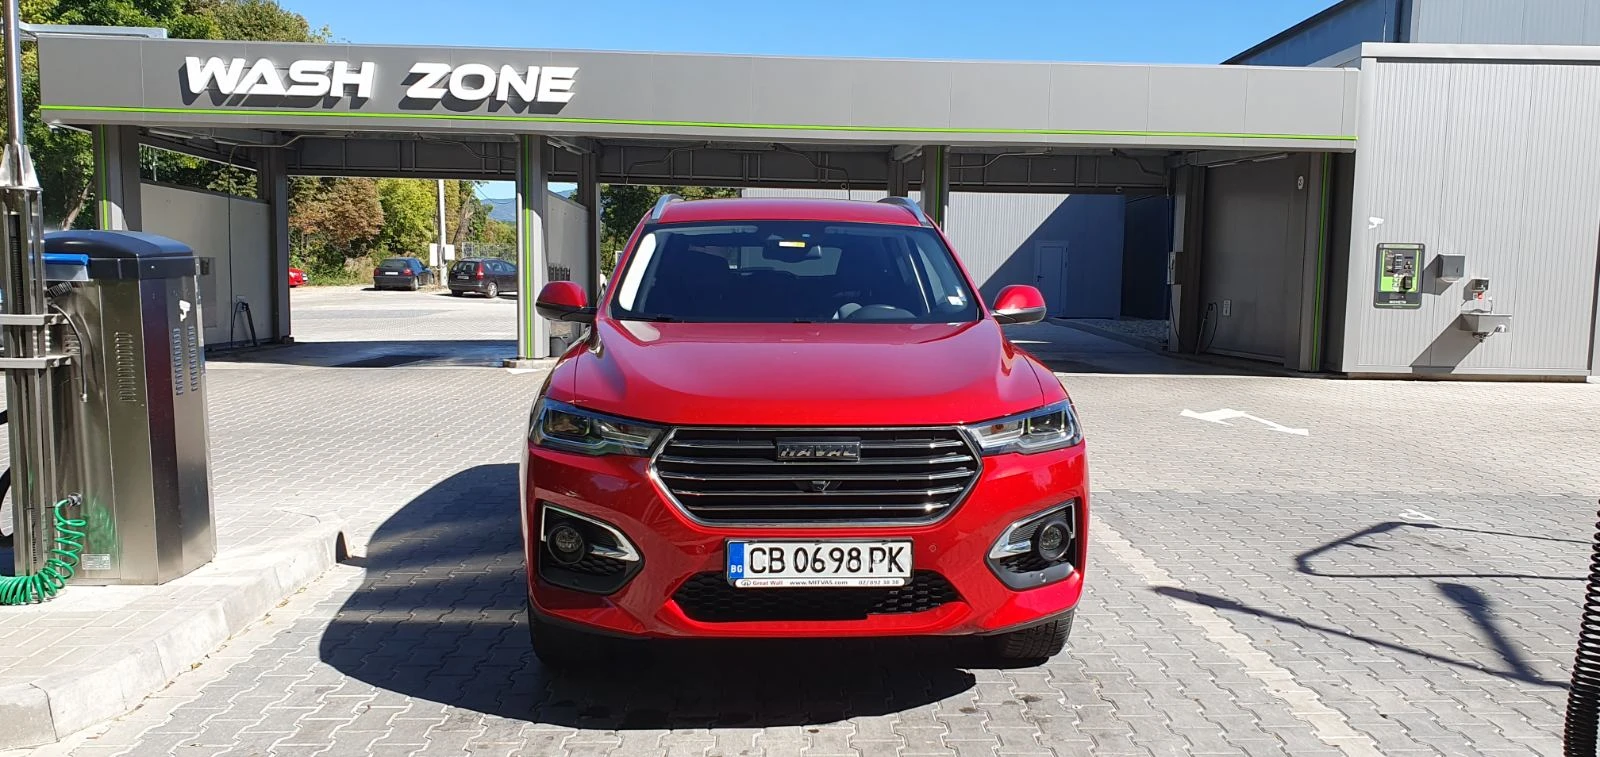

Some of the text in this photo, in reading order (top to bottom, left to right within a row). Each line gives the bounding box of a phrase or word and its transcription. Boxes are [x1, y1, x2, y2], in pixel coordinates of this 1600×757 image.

[184, 56, 580, 103] WASH ZONE
[779, 445, 857, 457] HAVAL
[730, 564, 743, 573] BG
[749, 546, 905, 574] CB 0698 PK
